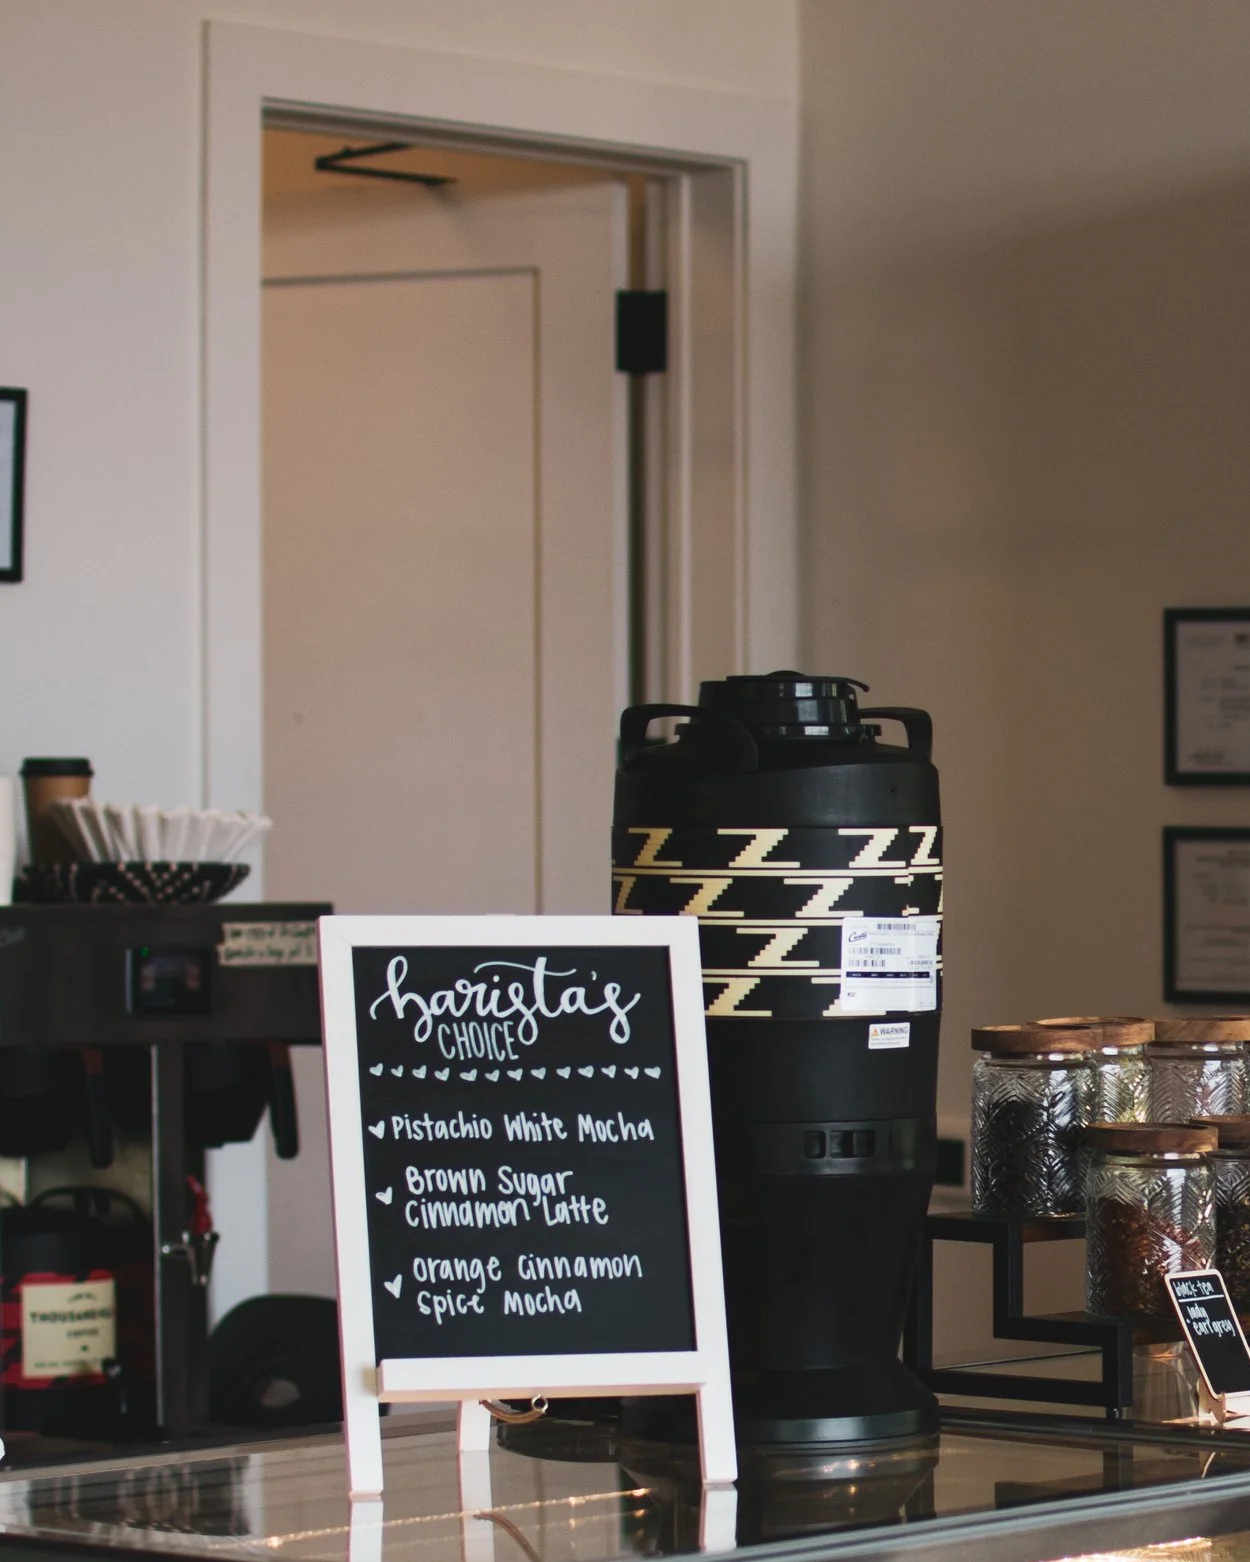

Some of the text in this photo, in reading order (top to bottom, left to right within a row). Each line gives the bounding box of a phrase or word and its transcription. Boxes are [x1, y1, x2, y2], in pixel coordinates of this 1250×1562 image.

[438, 1020, 520, 1061] CHOICE
[880, 1027, 908, 1035] WARNING
[391, 1111, 655, 1143] Pistachio White Mocha
[405, 1165, 574, 1206] Brown Sugar
[543, 1195, 609, 1227] Latte
[1173, 1280, 1214, 1297] black tea
[1186, 1302, 1210, 1320] lady
[1193, 1319, 1236, 1338] earl grey
